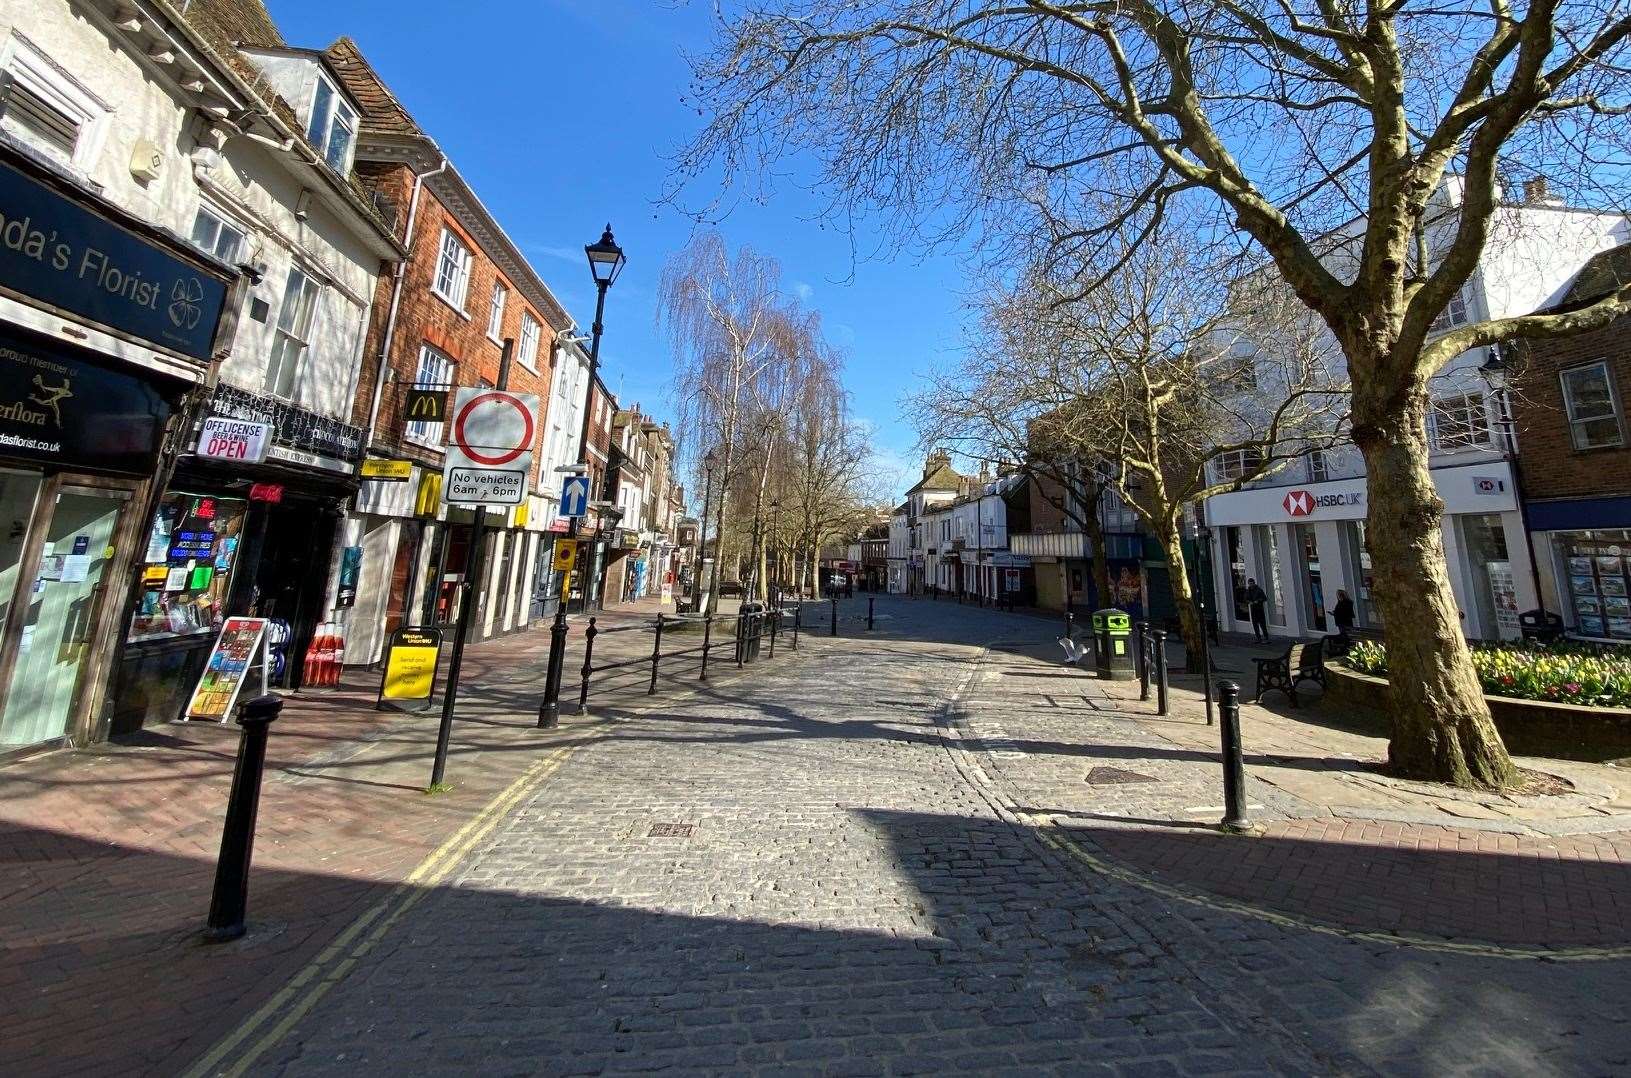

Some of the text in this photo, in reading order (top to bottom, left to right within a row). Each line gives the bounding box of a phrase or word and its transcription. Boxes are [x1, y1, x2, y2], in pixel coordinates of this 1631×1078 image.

[79, 247, 161, 310] Florist
[212, 431, 229, 440] BEER
[234, 434, 251, 442] WINE
[207, 438, 248, 459] OPEN
[454, 473, 519, 485] No vehicles
[453, 484, 477, 494] 6am
[492, 486, 517, 497] 6pm
[1316, 492, 1361, 508] HSBC UK
